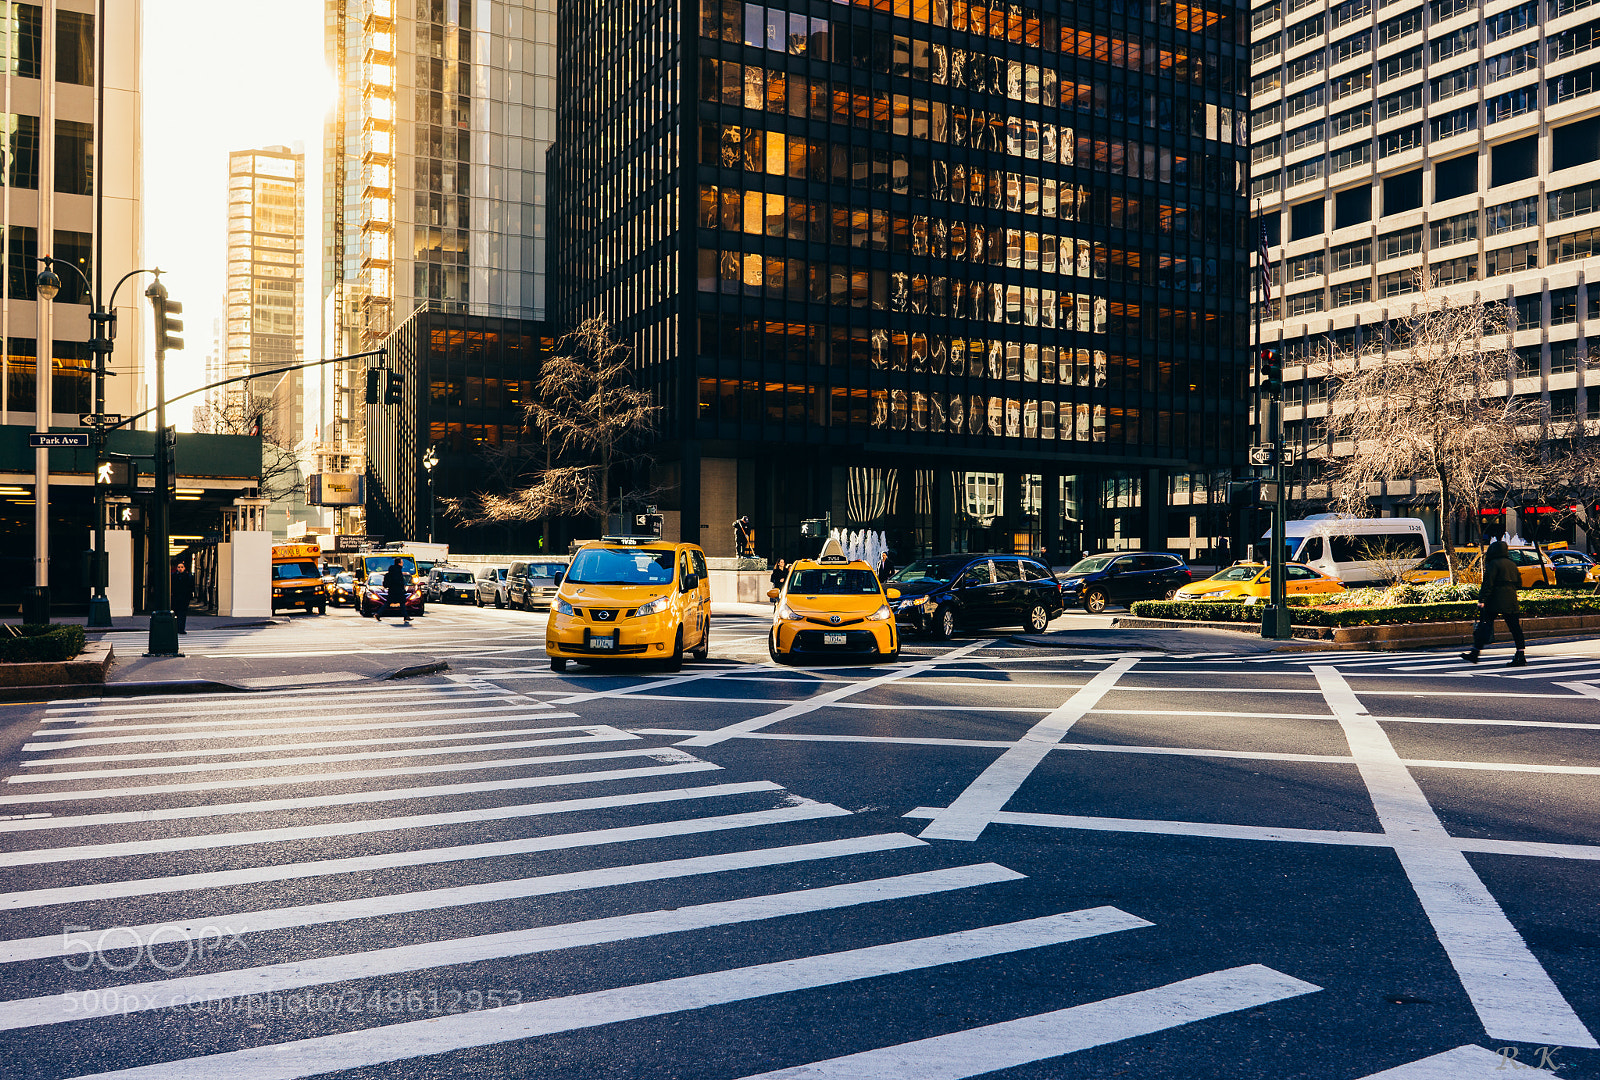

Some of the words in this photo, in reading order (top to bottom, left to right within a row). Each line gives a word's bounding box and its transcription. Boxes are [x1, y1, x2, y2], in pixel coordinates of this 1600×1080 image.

[39, 436, 60, 445] Park
[61, 436, 79, 445] Ave
[1255, 452, 1270, 460] ONE
